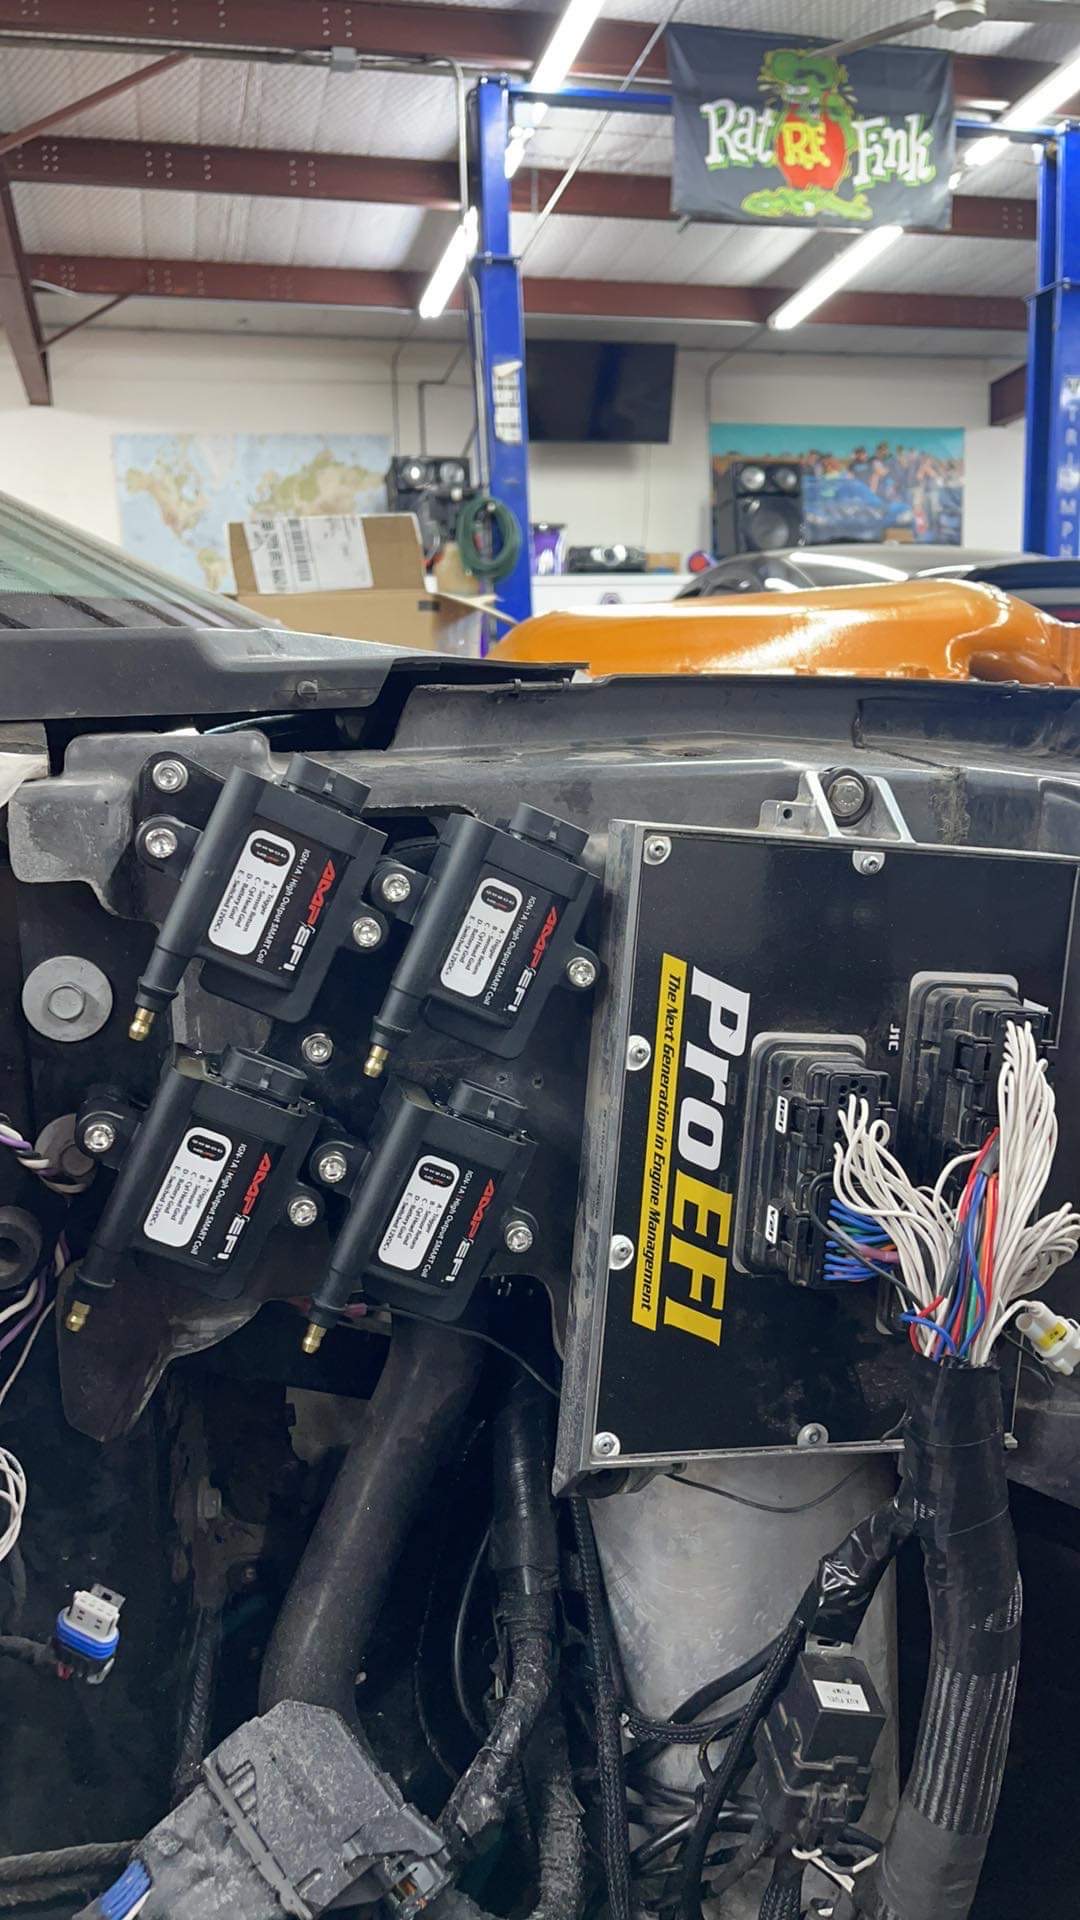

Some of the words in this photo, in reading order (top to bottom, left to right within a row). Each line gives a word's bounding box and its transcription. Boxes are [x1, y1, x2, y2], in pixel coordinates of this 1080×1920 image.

[700, 98, 776, 166] Rat
[852, 113, 935, 188] Fink
[294, 848, 311, 874] IGN-1A
[285, 878, 298, 896] High
[273, 896, 290, 923] Output
[520, 895, 537, 920] IGN-1A
[262, 922, 279, 949] SMART
[511, 923, 524, 941] High
[256, 949, 267, 964] Coil
[500, 941, 516, 966] Output
[489, 966, 505, 992] SMART
[667, 974, 681, 1003] The
[483, 991, 494, 1006] Coil
[664, 1007, 678, 1042] Next
[888, 1023, 900, 1051] J1C
[656, 1043, 674, 1133] Generation
[655, 1134, 667, 1151] in
[230, 1143, 247, 1168] IGN-1A
[663, 966, 751, 1346] ProEFI
[220, 1172, 234, 1189] High
[458, 1170, 474, 1194] IGN-1A
[649, 1152, 665, 1206] Engine
[208, 1189, 226, 1215] Output
[449, 1197, 461, 1215] High
[197, 1215, 214, 1241] SMART
[437, 1215, 454, 1240] Output
[190, 1240, 202, 1255] Coil
[427, 1239, 443, 1264] SMART
[641, 1209, 661, 1311] Management
[421, 1264, 431, 1278] Coil
